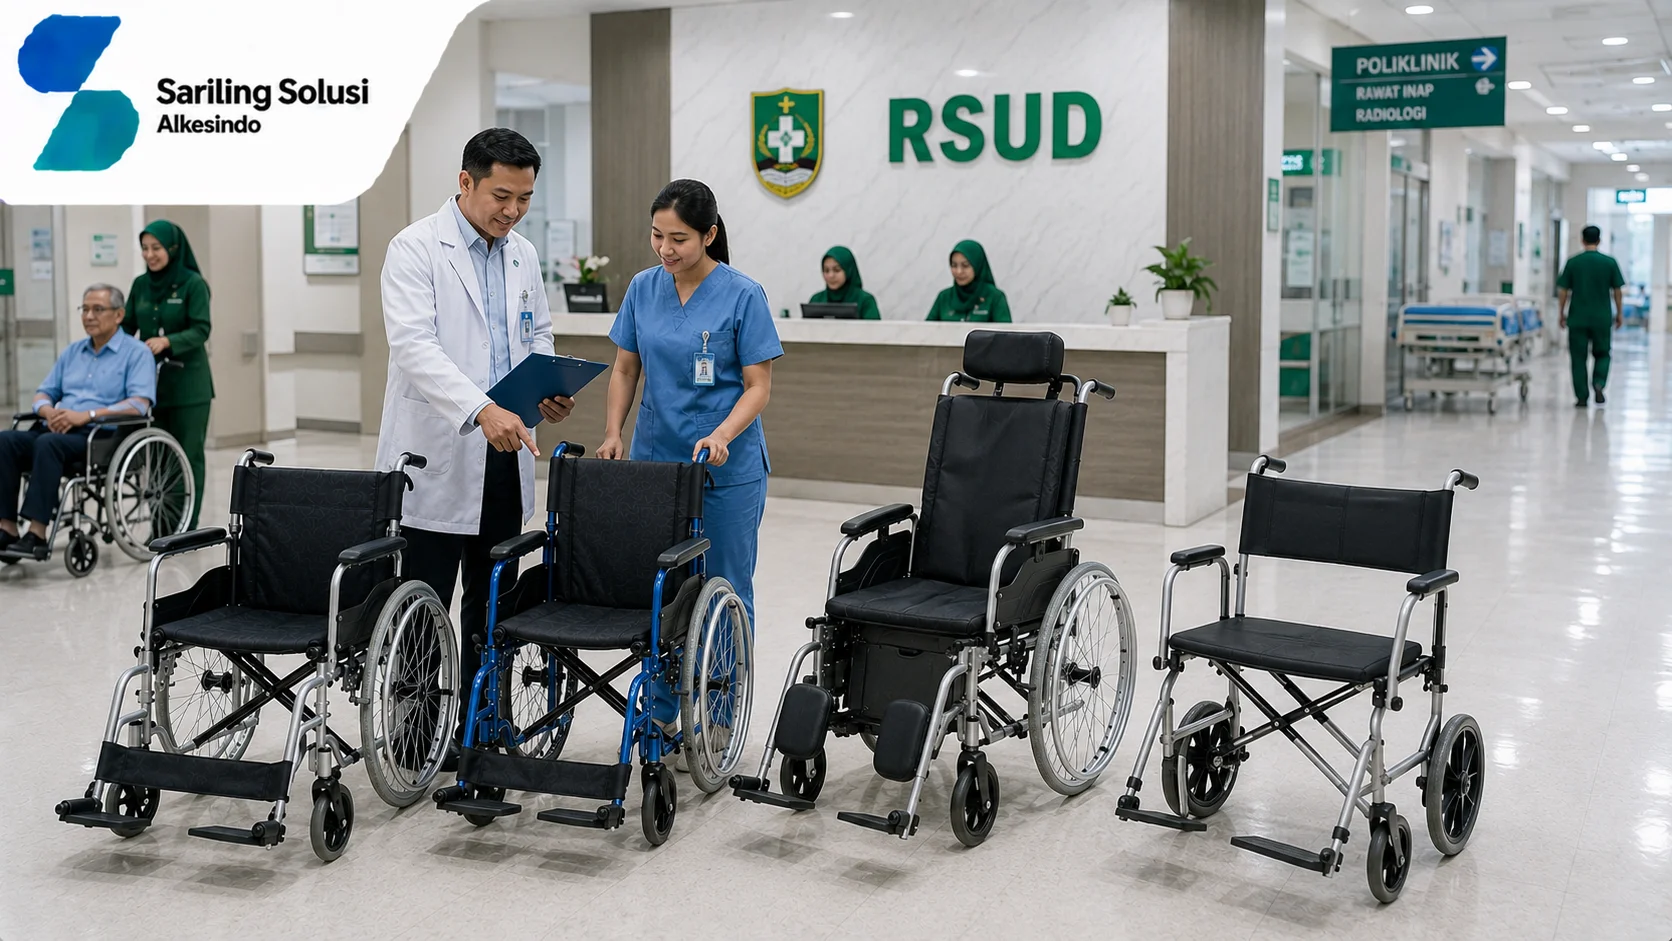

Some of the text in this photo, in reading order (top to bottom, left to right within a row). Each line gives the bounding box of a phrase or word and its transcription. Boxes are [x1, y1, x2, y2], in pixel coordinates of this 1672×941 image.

[1356, 52, 1460, 75] POLIKLINIK
[1356, 83, 1435, 101] RAWAT INAP
[1356, 106, 1427, 122] RADIOLOGI
[889, 91, 1103, 163] RSUD
